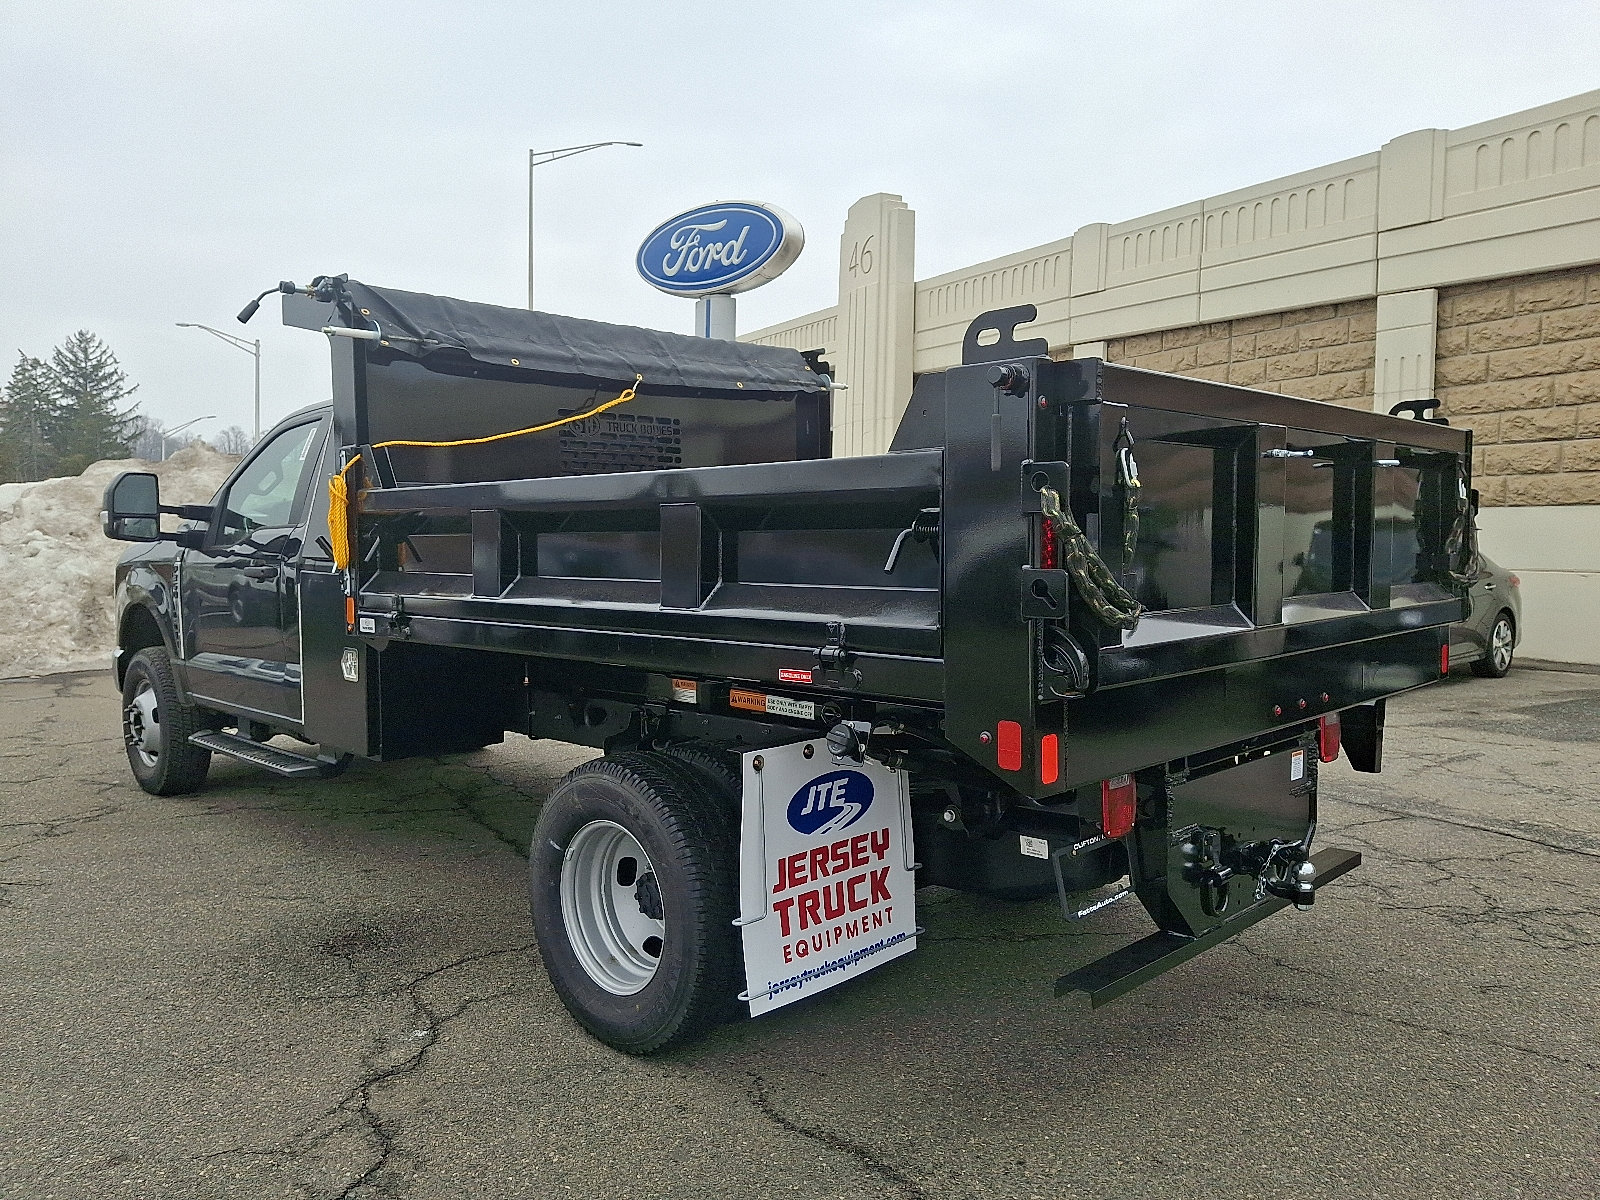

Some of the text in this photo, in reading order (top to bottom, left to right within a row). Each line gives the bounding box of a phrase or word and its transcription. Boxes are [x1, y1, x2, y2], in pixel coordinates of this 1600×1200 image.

[662, 219, 750, 276] Ford
[848, 234, 875, 278] 46
[607, 421, 638, 434] TRUCK
[738, 695, 766, 707] WARNING
[801, 777, 850, 816] JTE
[772, 828, 890, 894] JERSEY
[772, 866, 892, 938] TRUCK
[783, 906, 894, 964] EQUIPMENT
